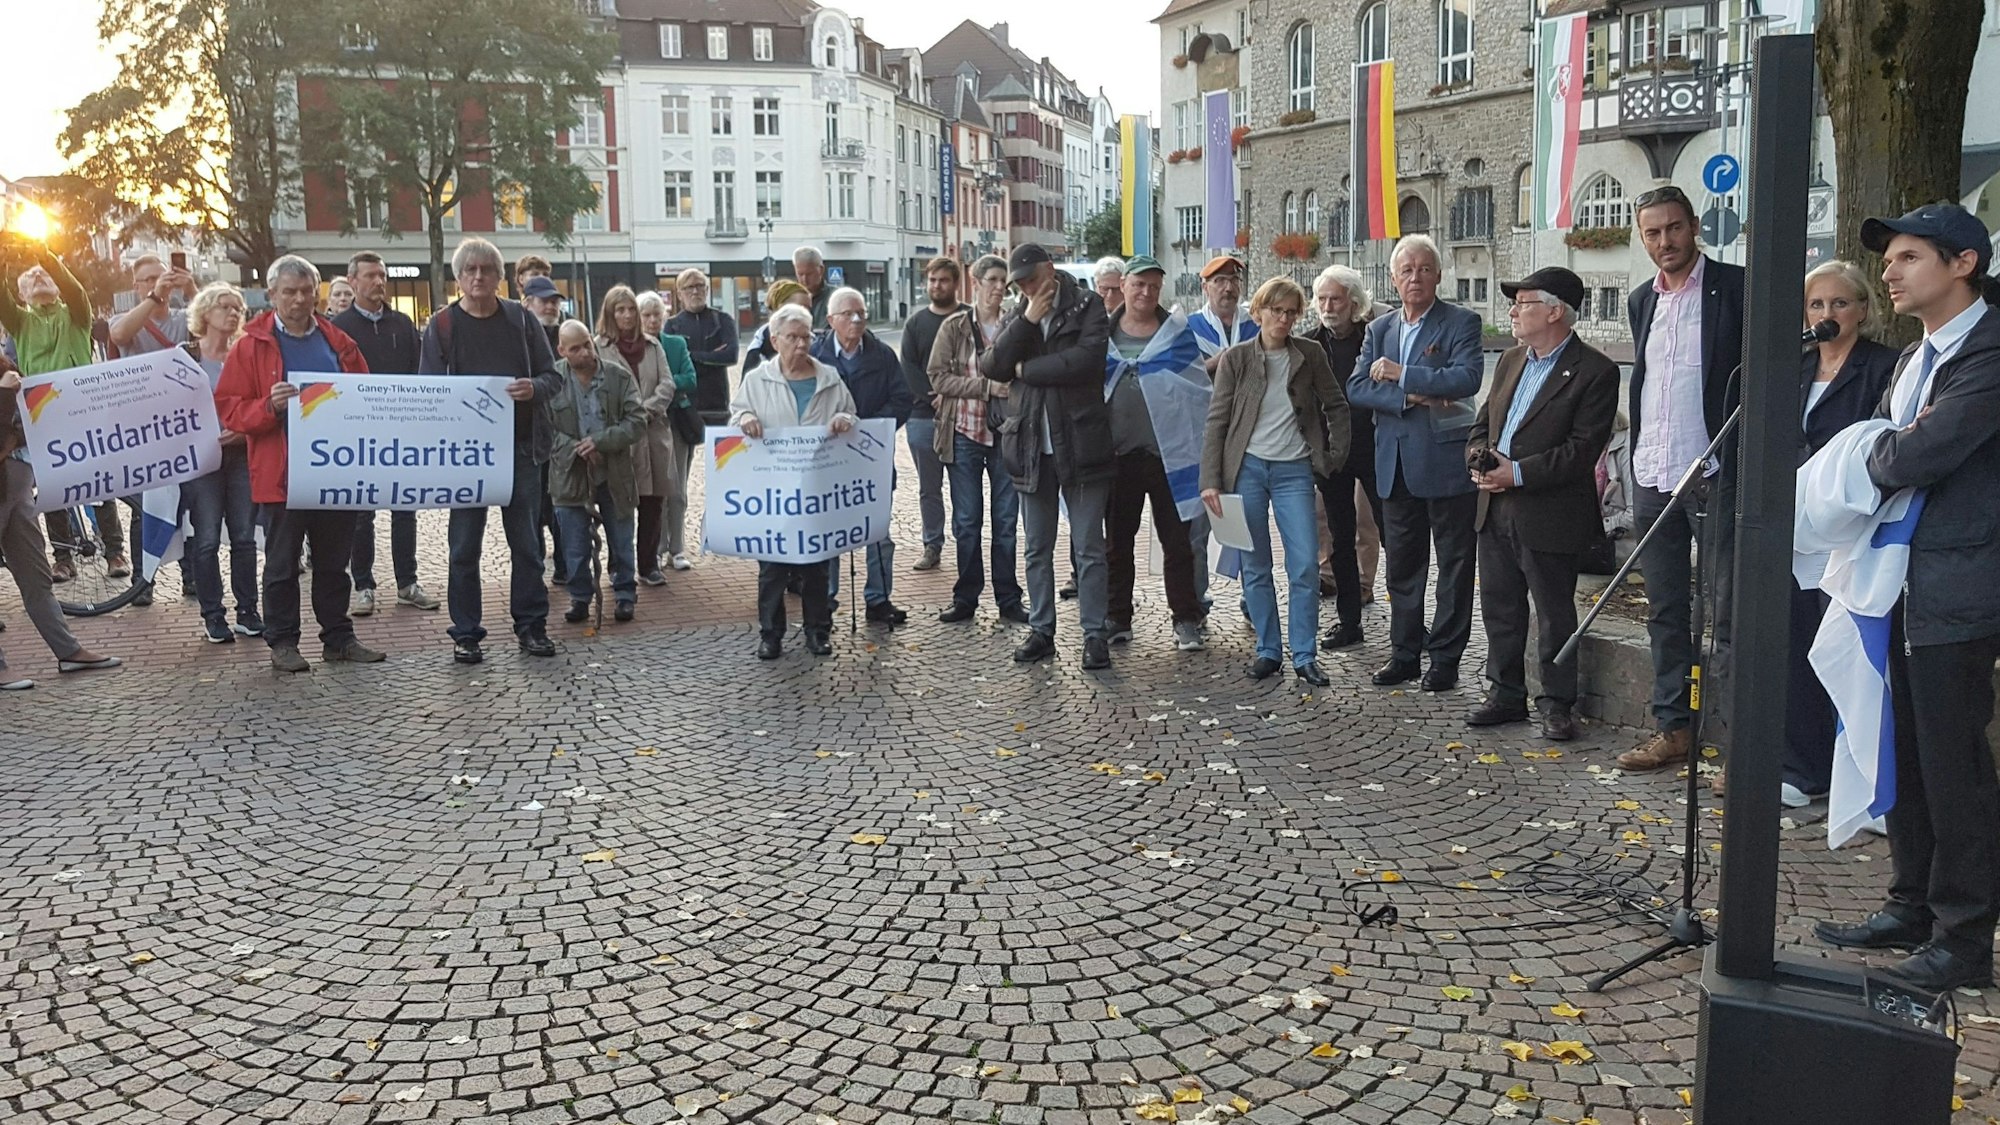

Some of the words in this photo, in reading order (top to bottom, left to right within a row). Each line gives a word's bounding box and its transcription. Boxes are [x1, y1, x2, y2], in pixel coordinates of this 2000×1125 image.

[388, 266, 420, 277] KIND
[73, 363, 153, 387] Ganey-Tikva-Verein
[357, 384, 451, 395] Ganey-Tikva-Verein
[398, 396, 433, 405] Förderung
[371, 405, 438, 413] Städtepartnerschaft
[389, 414, 418, 422] Bergisch
[418, 414, 448, 422] Gladbach
[47, 408, 202, 469] Solidarität
[310, 438, 495, 467] Solidarität
[63, 470, 114, 504] mit
[123, 445, 199, 489] Israel
[319, 480, 380, 505] mit
[391, 479, 484, 505] Israel
[725, 478, 877, 516] Solidarität
[734, 529, 787, 555] mit
[798, 516, 870, 555] Israel
